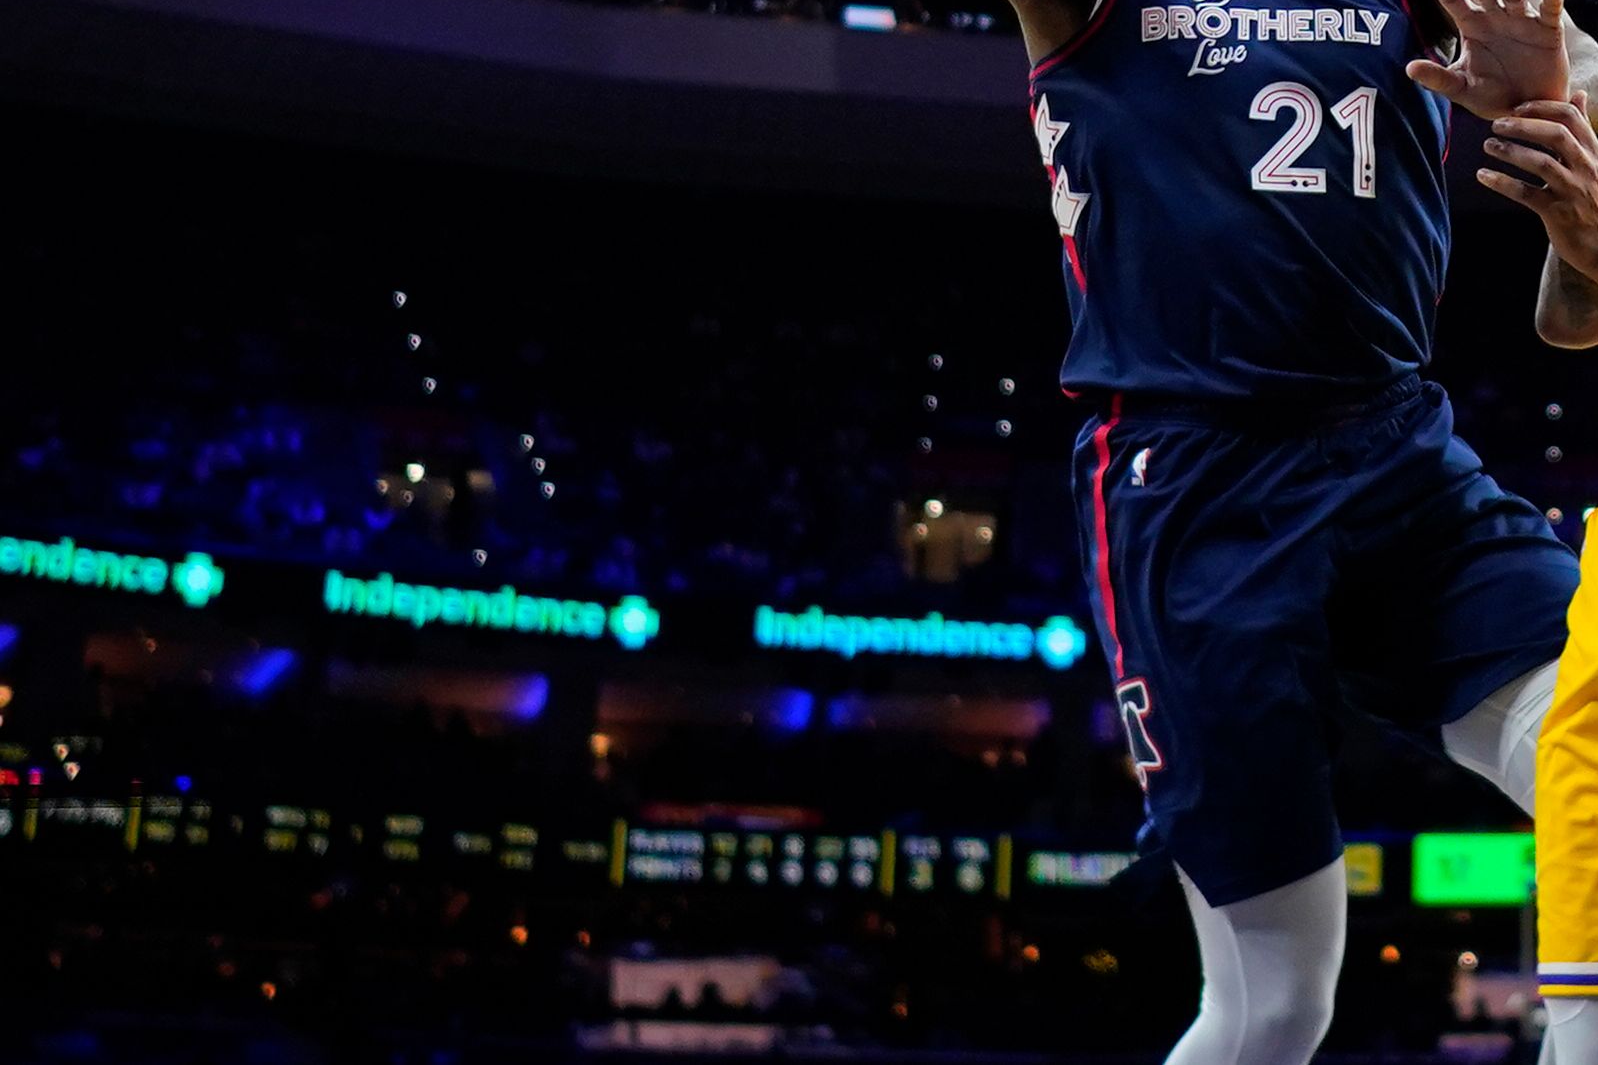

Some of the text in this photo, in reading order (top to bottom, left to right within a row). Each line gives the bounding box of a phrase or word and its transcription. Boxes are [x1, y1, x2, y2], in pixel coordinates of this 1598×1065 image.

[1141, 5, 1390, 46] BROTHERLY
[1187, 37, 1247, 77] Love
[1249, 81, 1378, 199] 21
[0, 536, 168, 595] endence
[324, 568, 605, 640] Independence
[754, 604, 1034, 659] Independence
